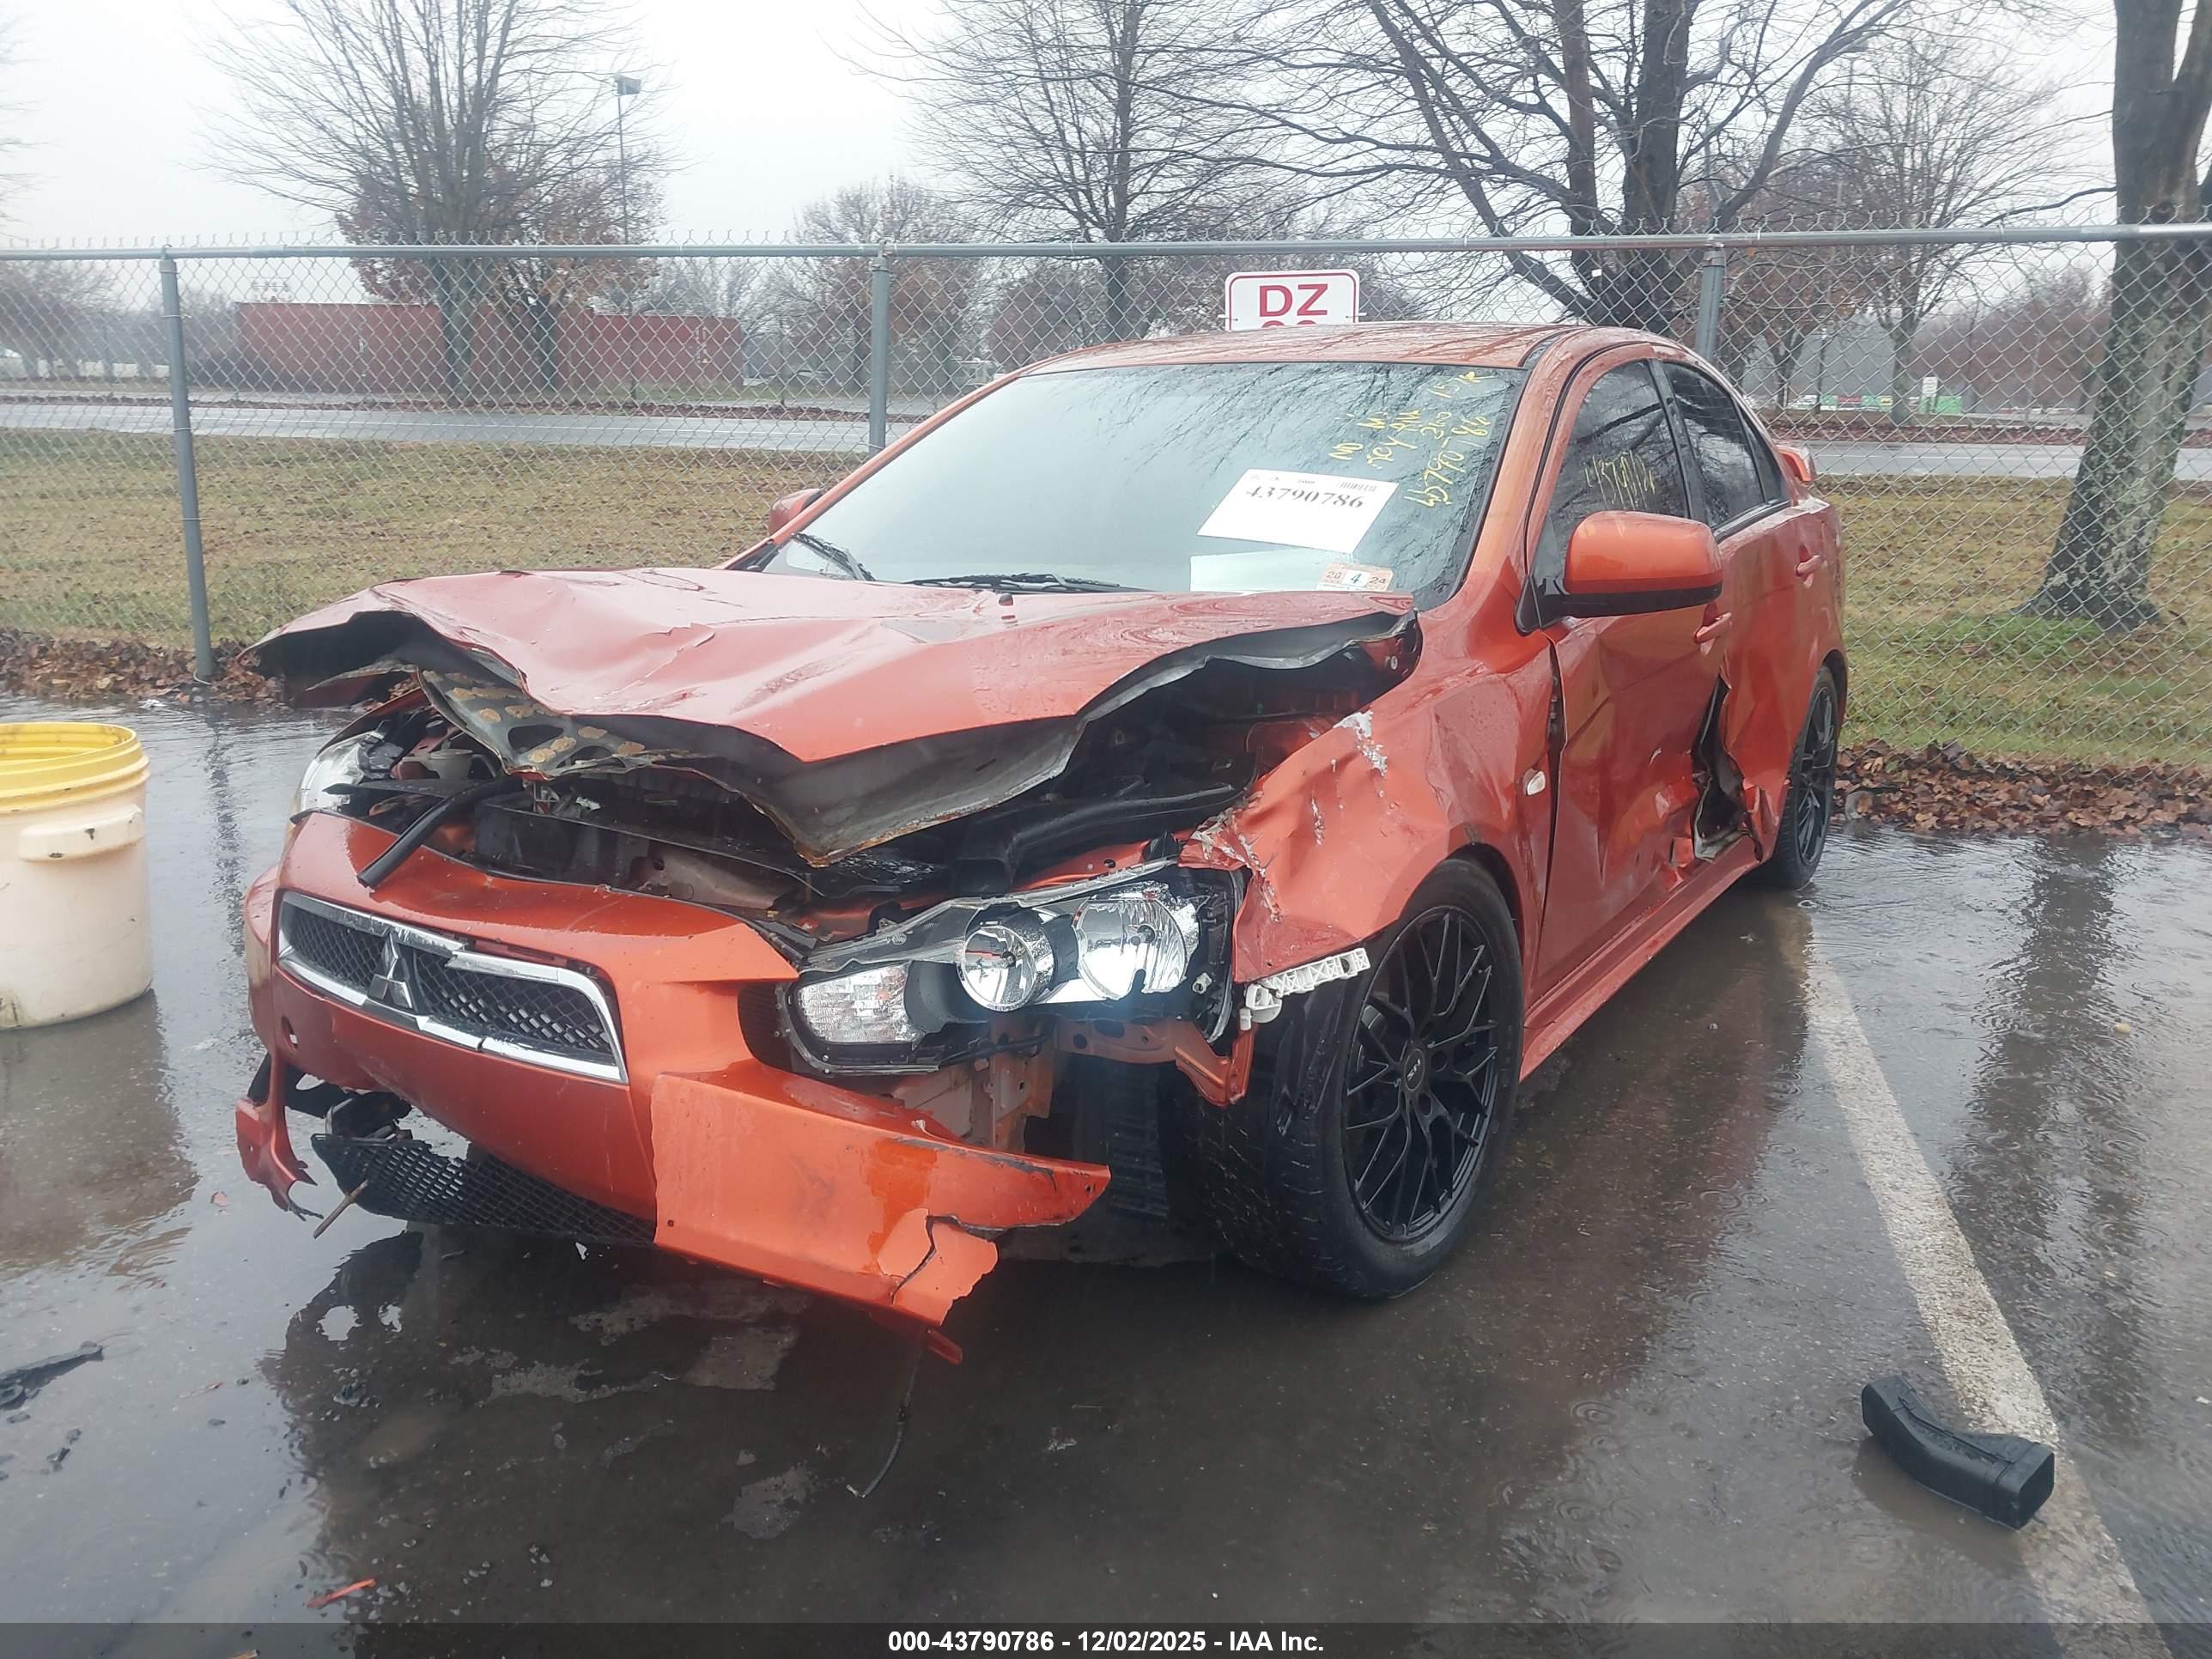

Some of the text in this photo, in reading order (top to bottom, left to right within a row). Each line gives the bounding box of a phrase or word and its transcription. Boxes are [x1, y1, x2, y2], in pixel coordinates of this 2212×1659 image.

[1259, 283, 1328, 317] DZ
[1246, 486, 1365, 508] 43790786
[1350, 573, 1363, 584] 4
